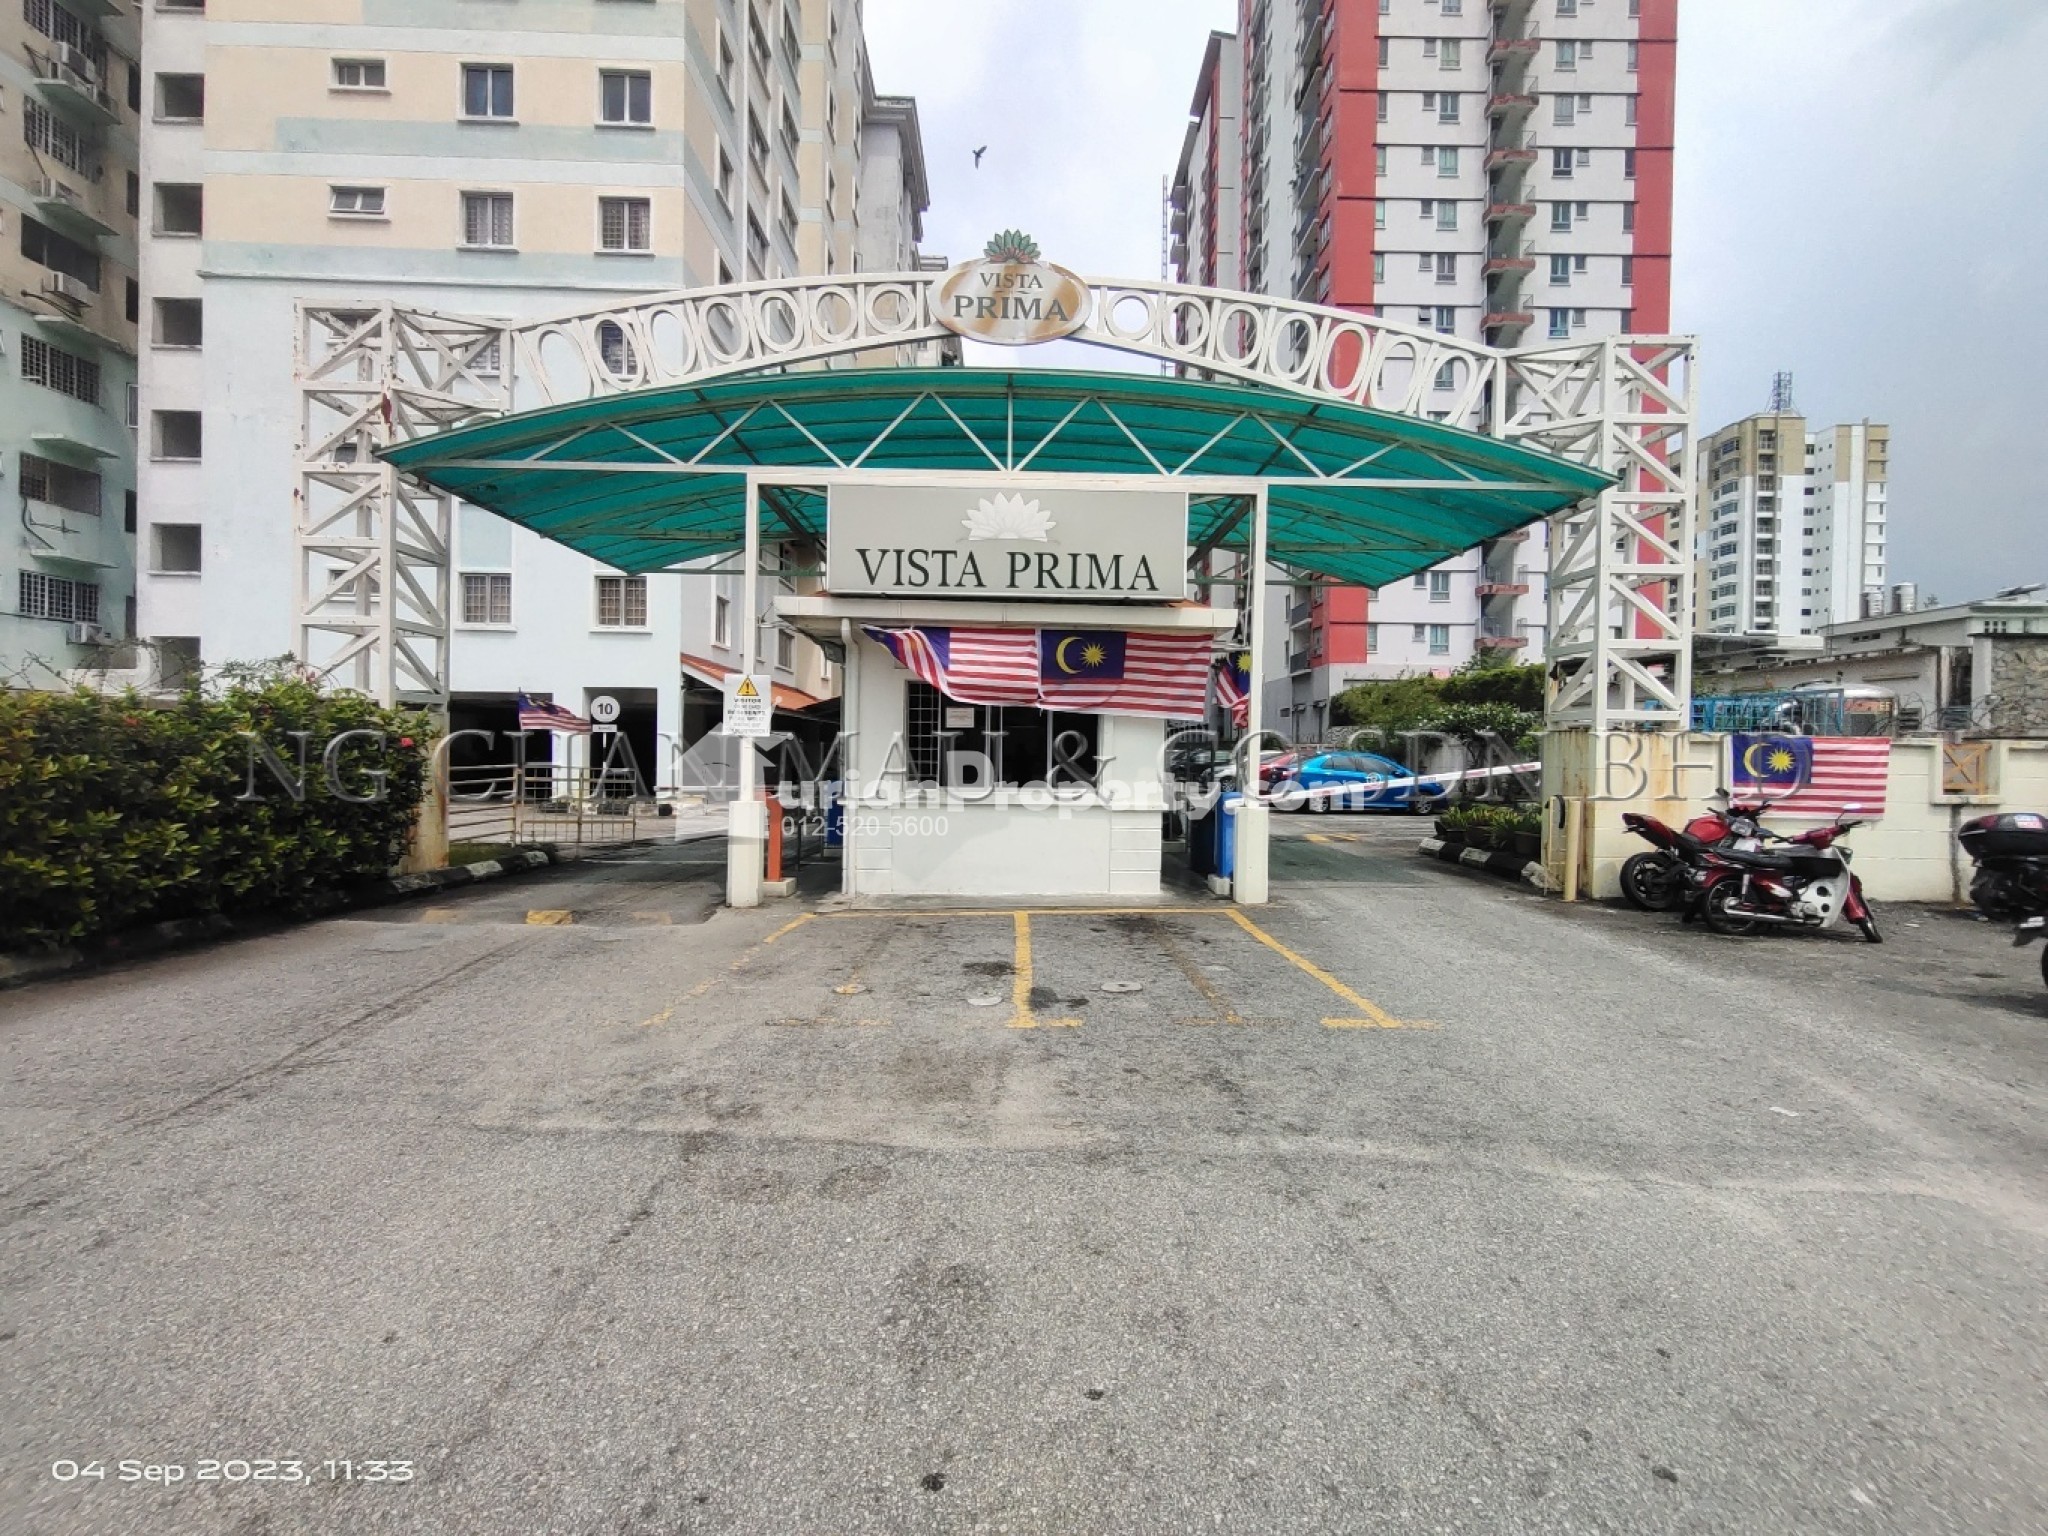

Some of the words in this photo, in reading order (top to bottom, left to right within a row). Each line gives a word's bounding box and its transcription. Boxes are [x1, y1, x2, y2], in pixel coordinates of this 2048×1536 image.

[979, 272, 1044, 289] VISTA
[953, 294, 1069, 321] PRIMA
[855, 548, 986, 587] VISTA
[1006, 551, 1160, 592] PRIMA
[597, 703, 613, 715] 10
